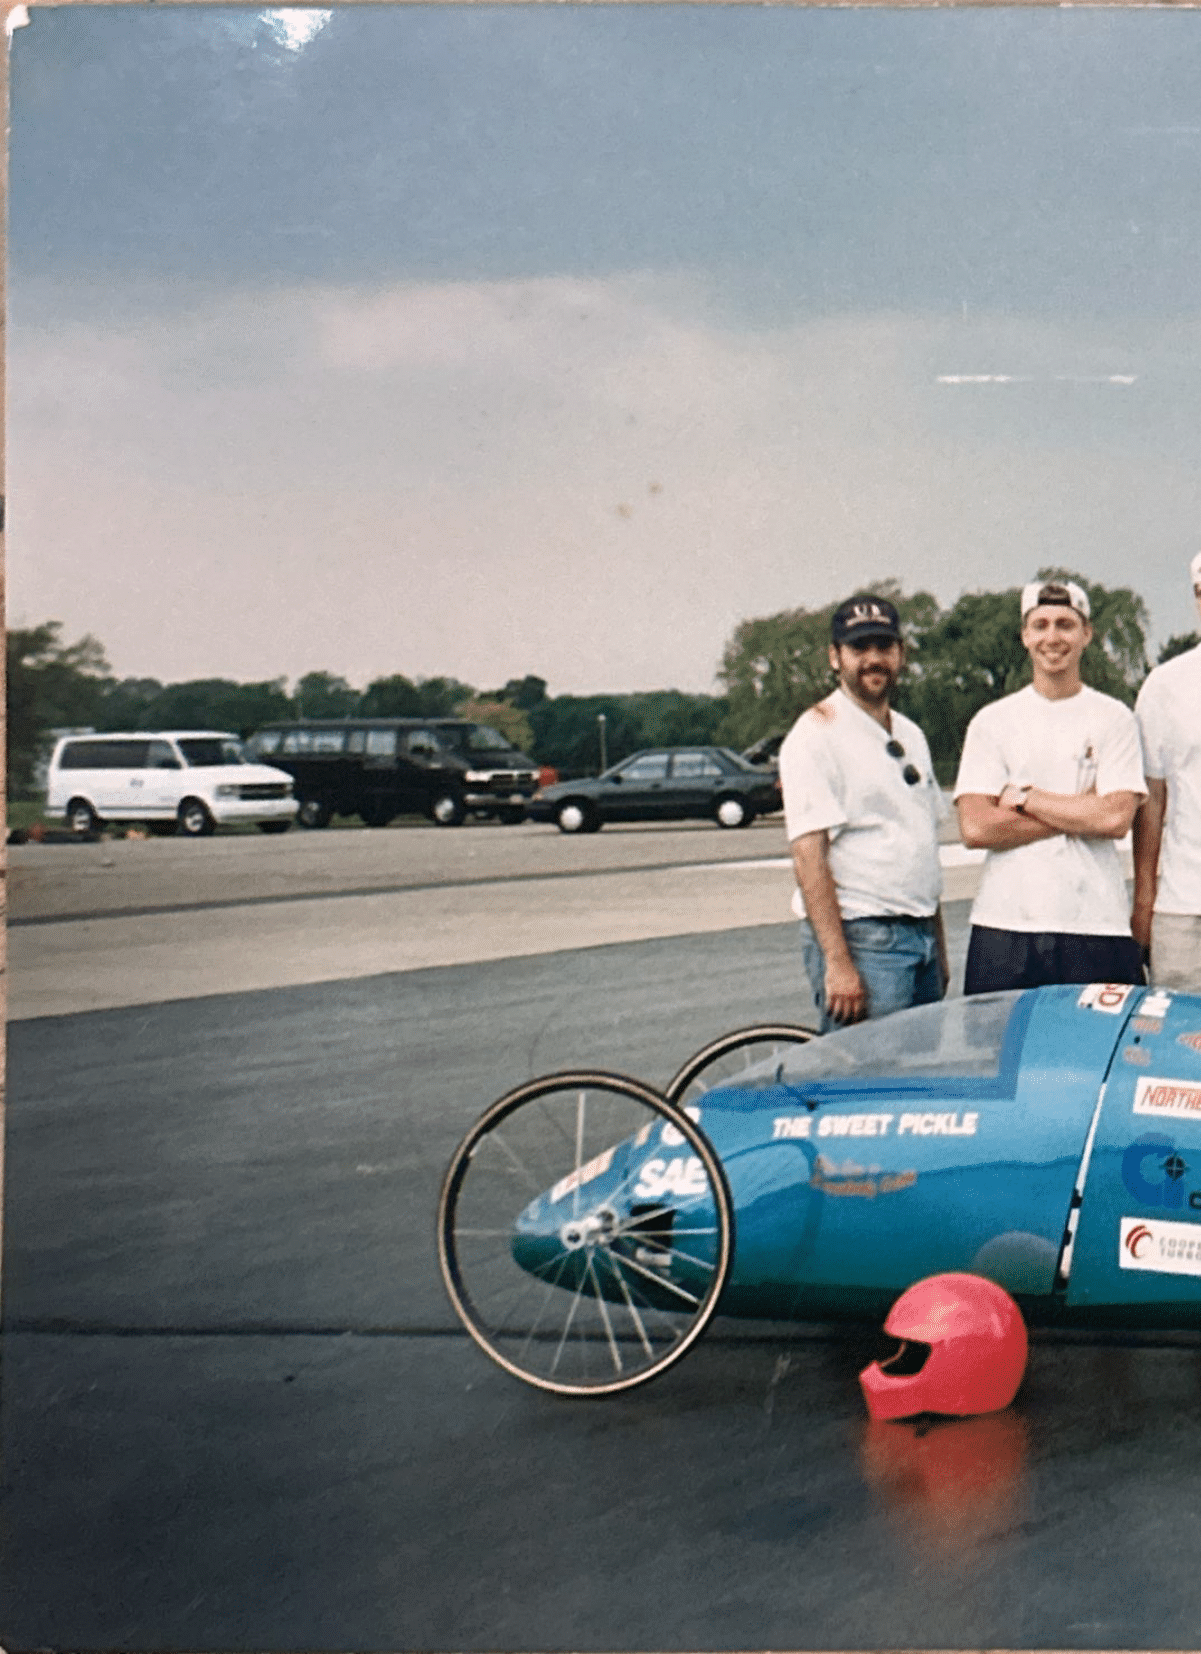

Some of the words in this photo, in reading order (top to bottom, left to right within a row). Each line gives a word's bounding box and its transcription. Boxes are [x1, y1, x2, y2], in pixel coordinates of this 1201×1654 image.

[772, 1116, 812, 1138] THE
[817, 1114, 894, 1137] SWEET
[898, 1113, 979, 1136] PICKLE
[633, 1156, 709, 1199] SAE
